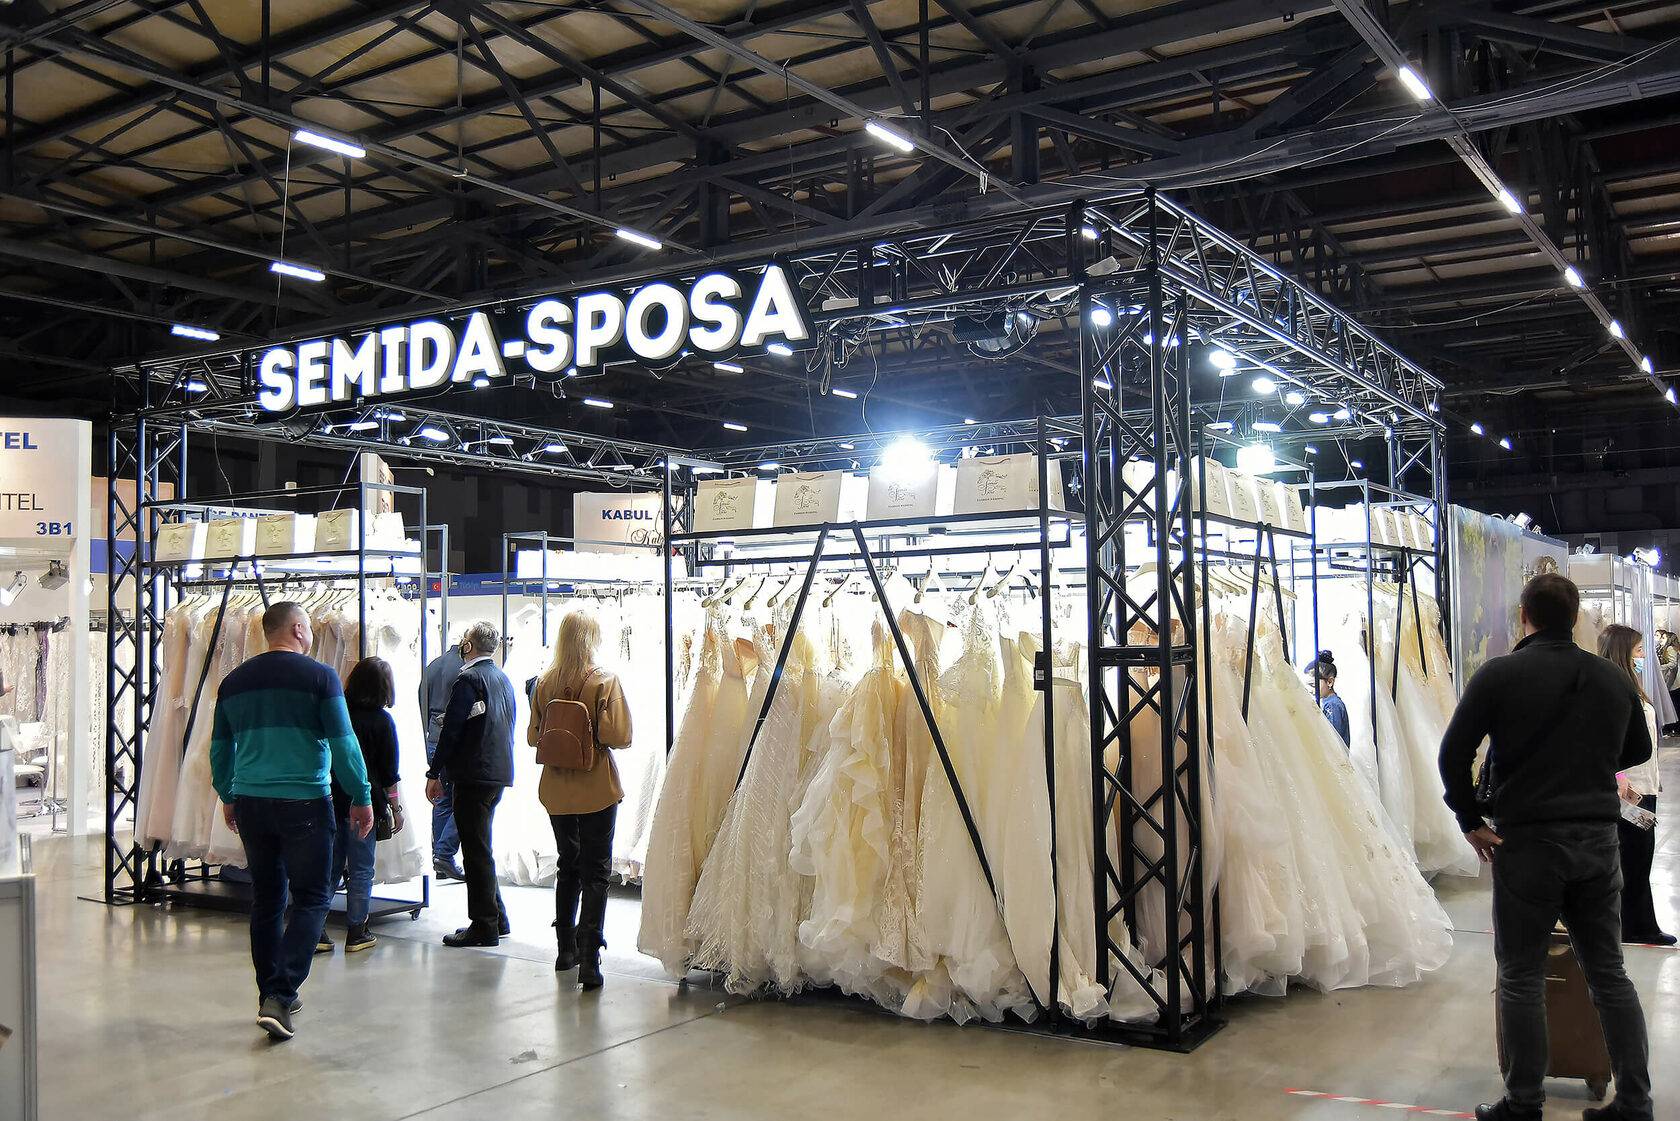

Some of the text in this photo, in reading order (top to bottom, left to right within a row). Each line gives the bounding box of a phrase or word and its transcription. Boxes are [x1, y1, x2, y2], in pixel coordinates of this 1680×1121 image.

[259, 264, 809, 412] SEMIDA-SPOSA
[0, 432, 38, 450] EL
[0, 493, 44, 511] TEL
[602, 509, 653, 520] KABUL
[36, 522, 72, 535] 3B1
